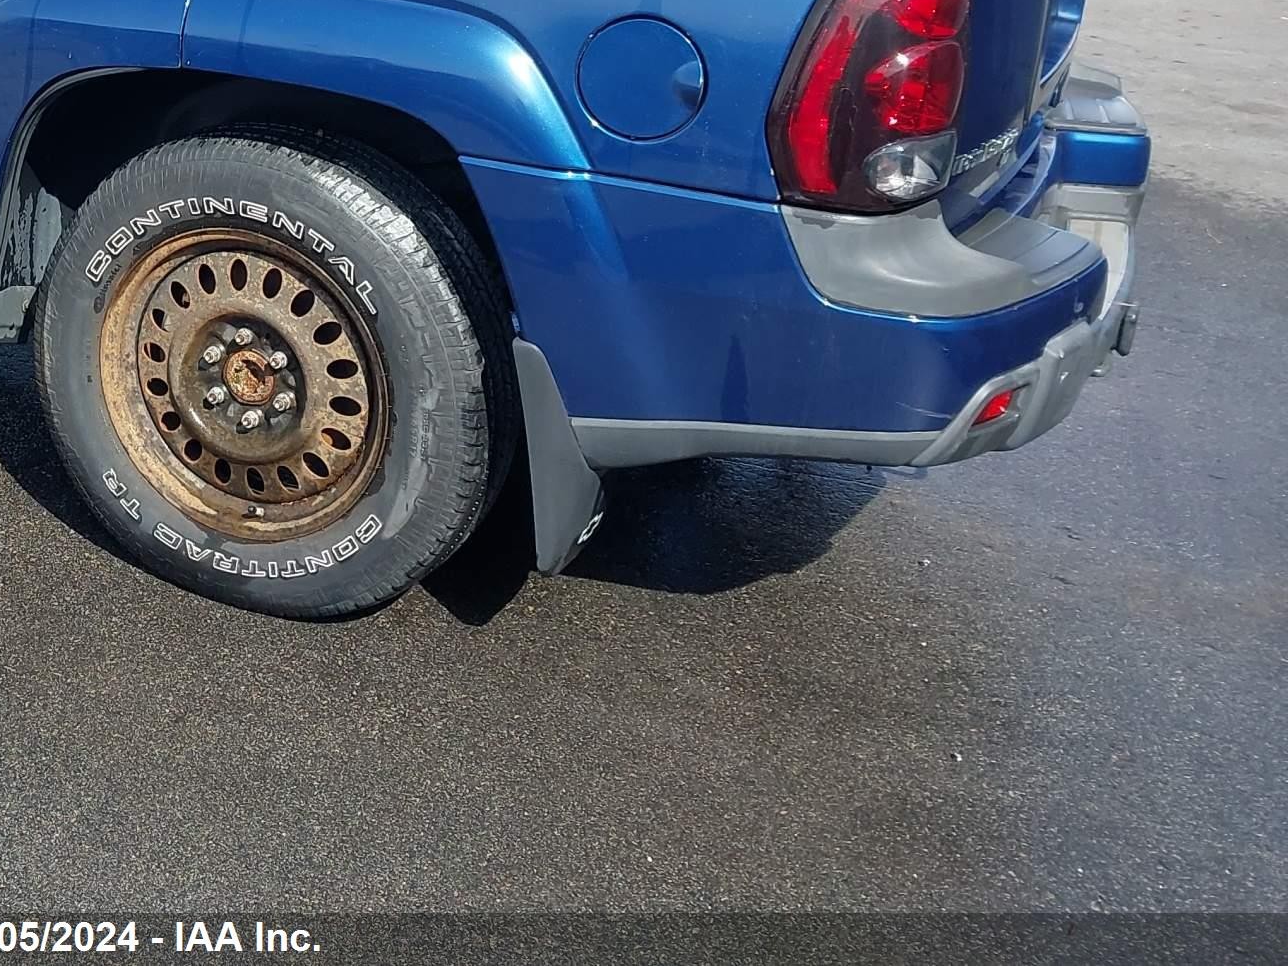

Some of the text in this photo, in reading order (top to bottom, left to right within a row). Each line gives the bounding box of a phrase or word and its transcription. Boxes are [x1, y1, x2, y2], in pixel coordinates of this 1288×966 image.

[86, 196, 378, 315] CONTINENTAL
[102, 468, 382, 578] CONTITRAC TR
